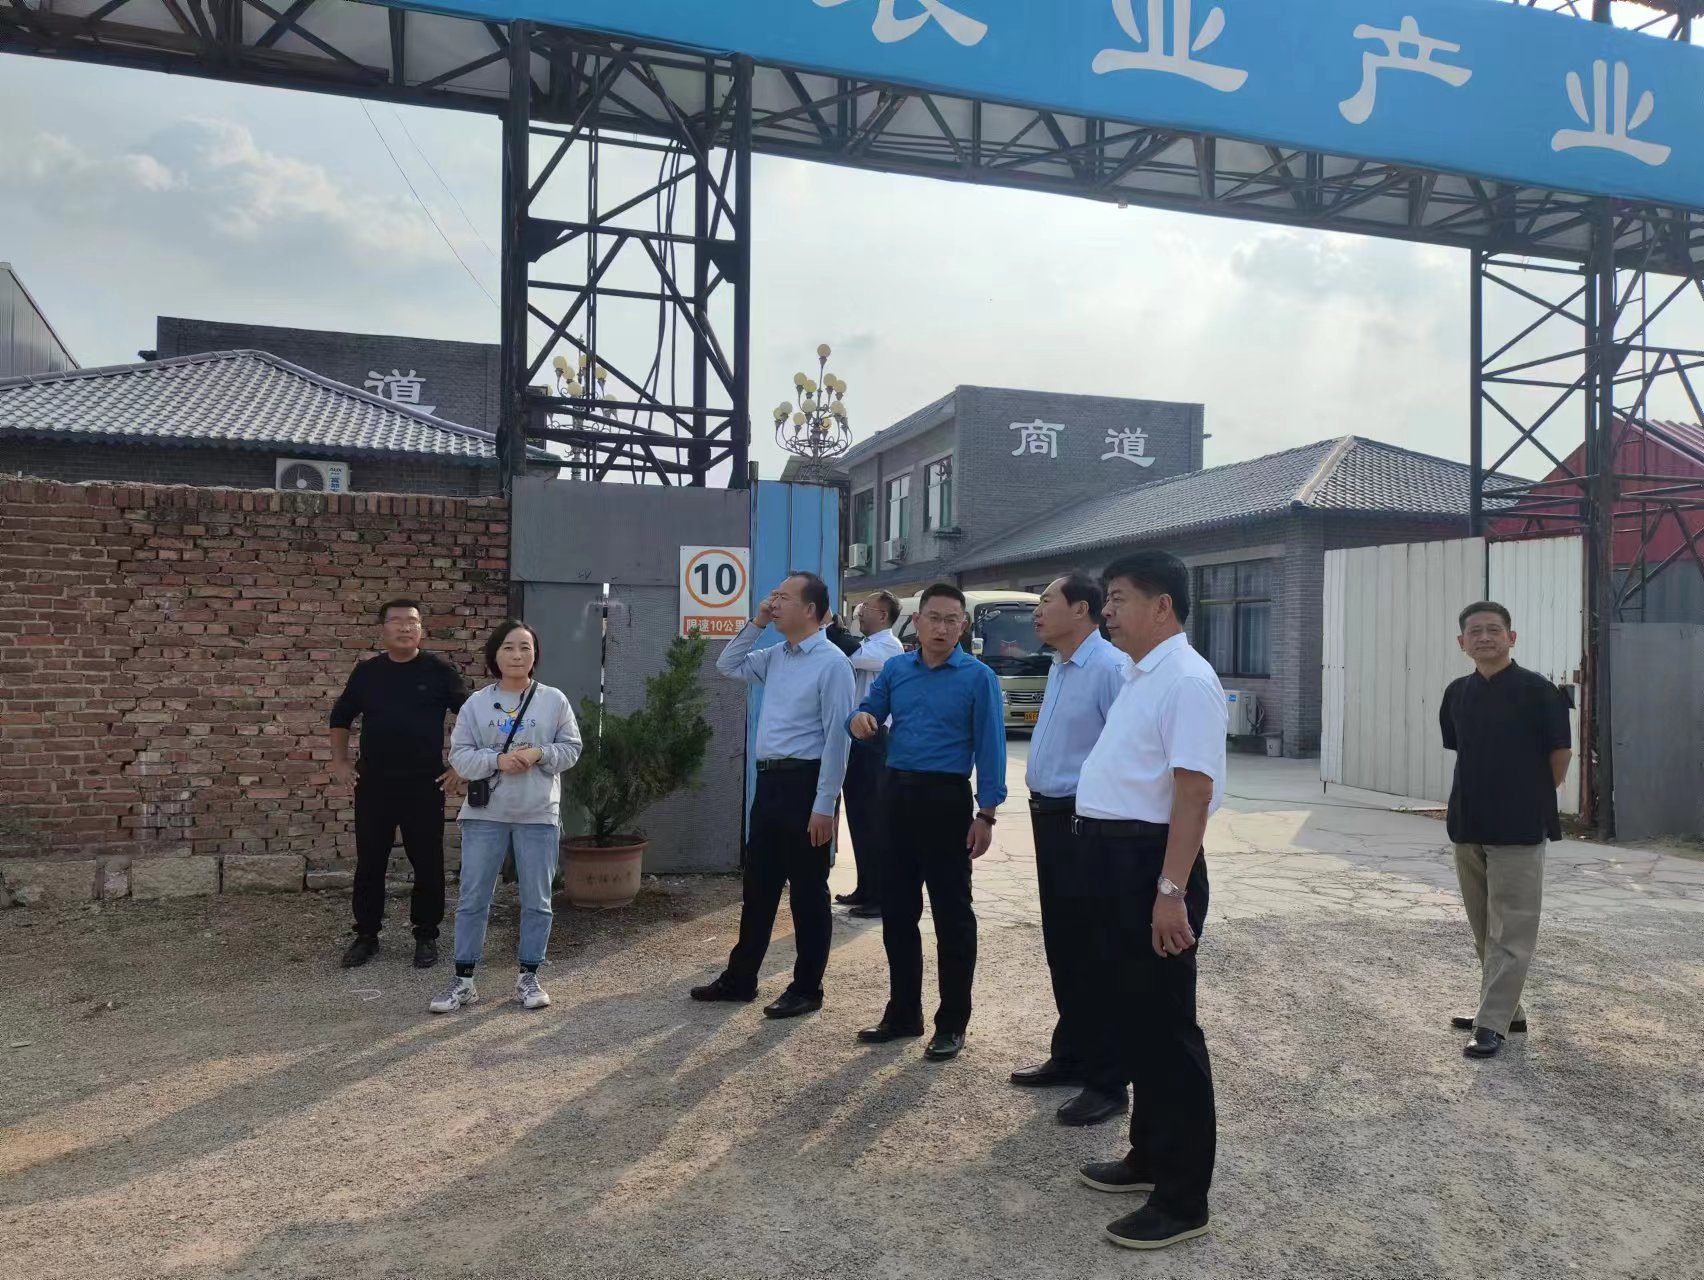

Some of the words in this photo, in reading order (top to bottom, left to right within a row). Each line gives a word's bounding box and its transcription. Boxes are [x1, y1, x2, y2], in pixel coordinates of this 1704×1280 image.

[363, 369, 436, 415] 道
[1009, 419, 1155, 468] 商道
[694, 563, 736, 595] 10
